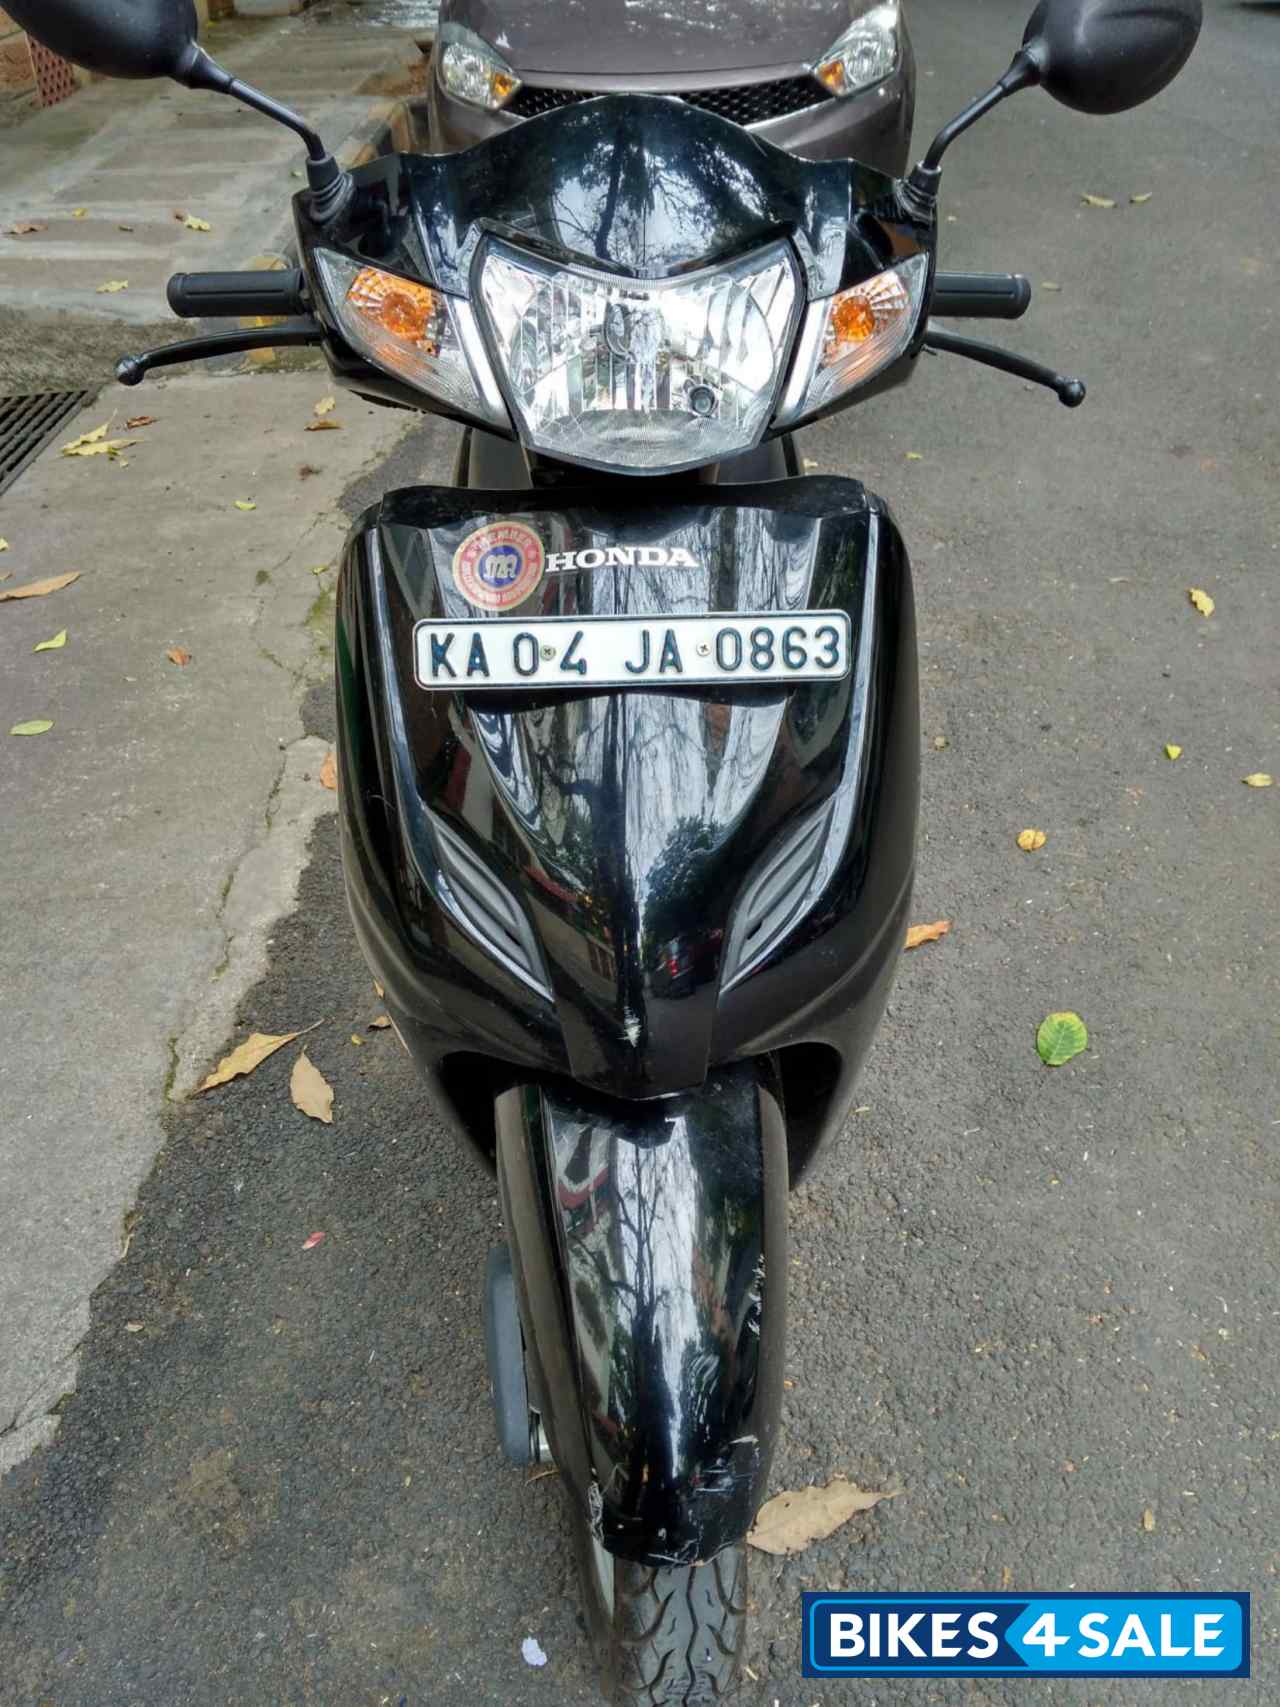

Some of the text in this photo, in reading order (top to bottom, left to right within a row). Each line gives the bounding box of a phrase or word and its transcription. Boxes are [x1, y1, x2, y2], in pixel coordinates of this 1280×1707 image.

[545, 546, 700, 573] HONDA
[430, 632, 490, 678] KA
[625, 628, 684, 675] JA
[715, 625, 841, 672] 0863
